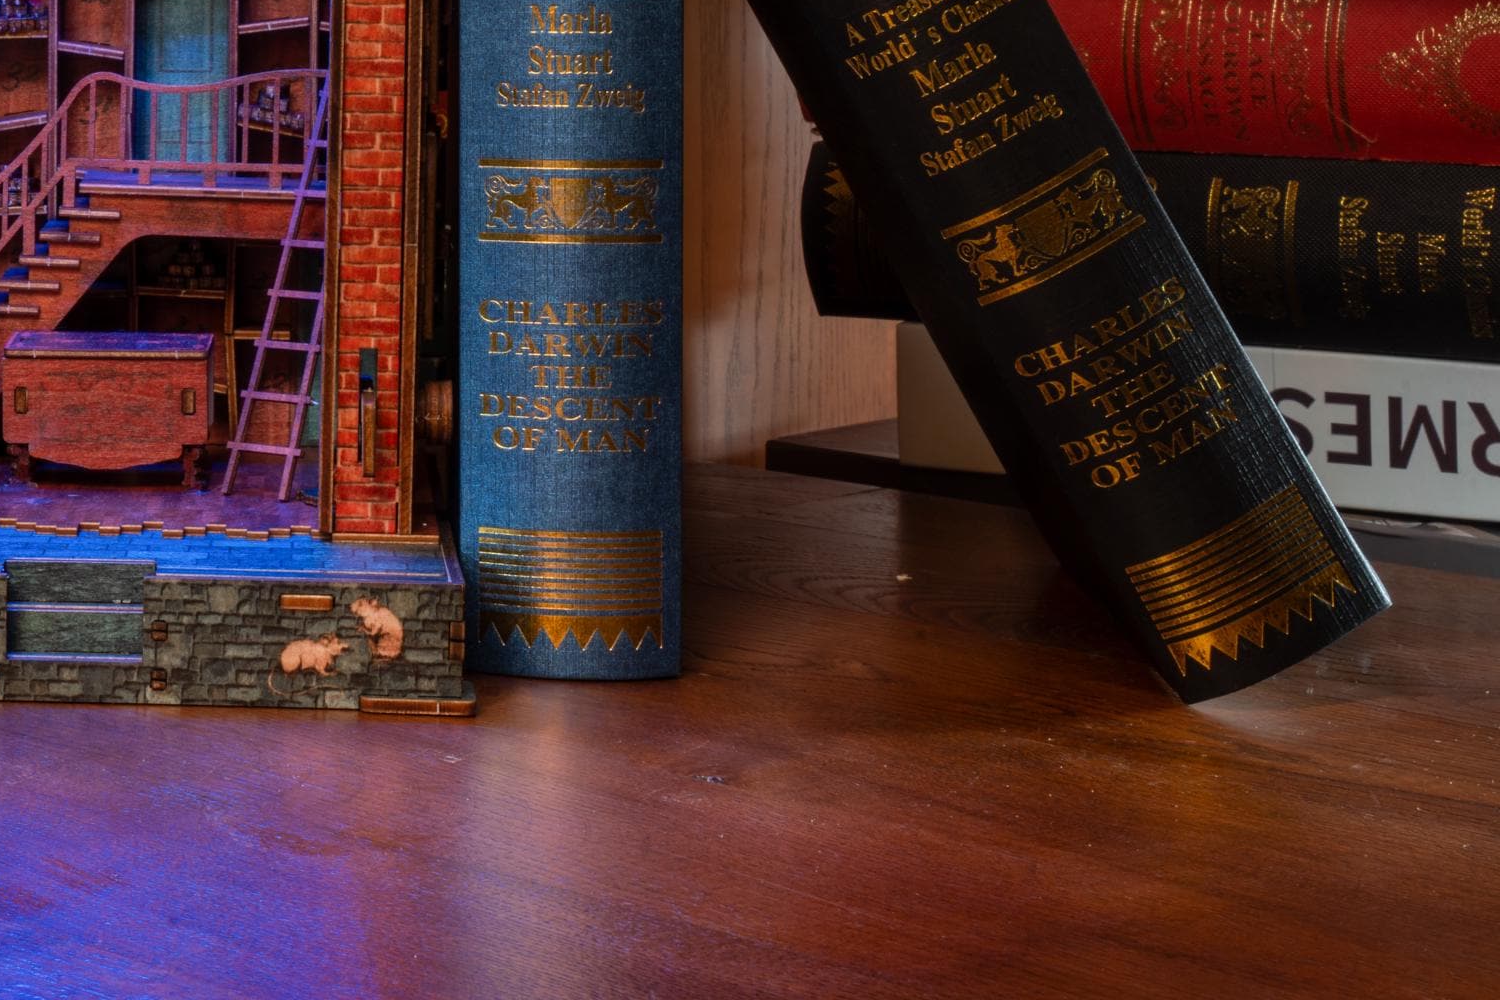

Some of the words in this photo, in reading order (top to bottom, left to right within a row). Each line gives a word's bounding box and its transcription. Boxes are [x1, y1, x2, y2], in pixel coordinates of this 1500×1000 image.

[529, 3, 613, 34] Marla
[845, 21, 866, 47] A
[528, 45, 613, 75] Stuart
[908, 41, 997, 98] Marla
[497, 81, 570, 108] Stafan
[576, 82, 646, 113] Zweig
[930, 73, 1017, 136] Stuart
[918, 132, 997, 177] Stafan
[994, 93, 1064, 142] Zweig
[478, 298, 665, 326] CHARLES
[1014, 276, 1186, 378] CHARLES
[488, 331, 653, 357] DARWIN
[1036, 310, 1193, 406] DARWIN
[529, 364, 613, 389] THE
[1091, 361, 1177, 419] THE
[479, 393, 661, 421] DESCENT
[1060, 363, 1232, 466] DESCENT
[492, 425, 545, 451] OF
[555, 428, 650, 453] MAN
[1091, 452, 1141, 488] OF
[1148, 398, 1238, 466] MAN
